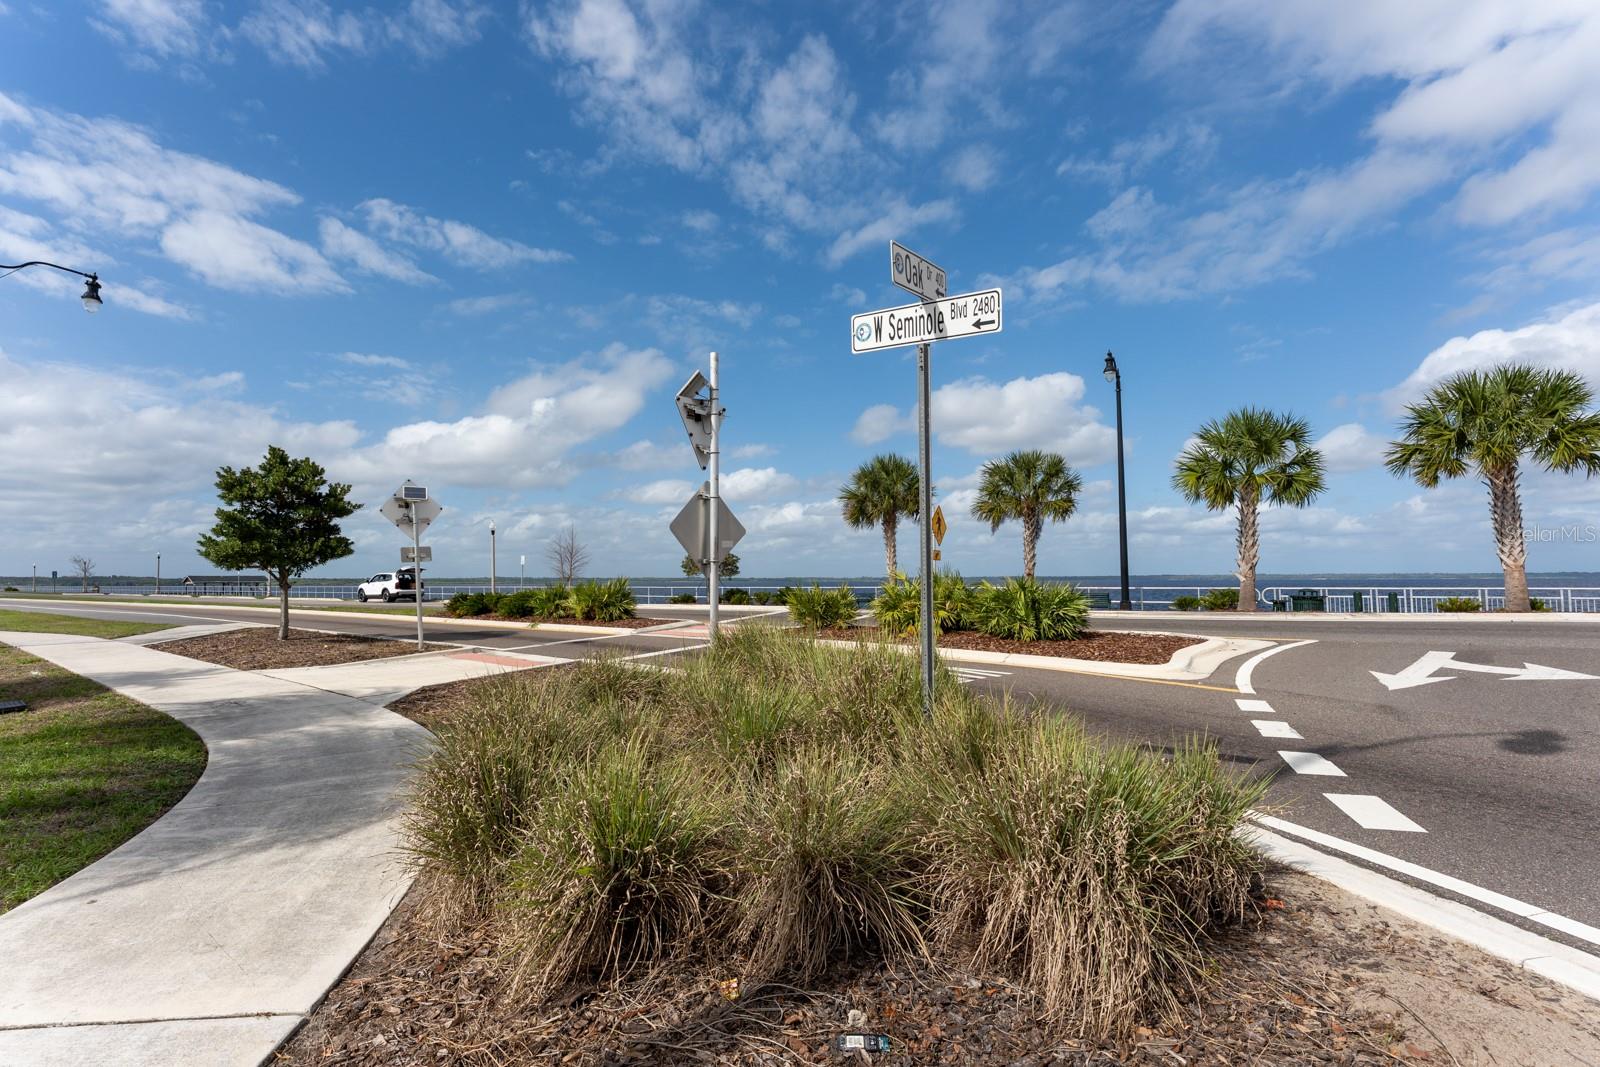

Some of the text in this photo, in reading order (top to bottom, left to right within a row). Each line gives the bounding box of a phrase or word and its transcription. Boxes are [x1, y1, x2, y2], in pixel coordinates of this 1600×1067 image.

[904, 254, 924, 290] Oak
[926, 266, 933, 281] Dr
[873, 295, 996, 343] W Seminole Blvd 2480
